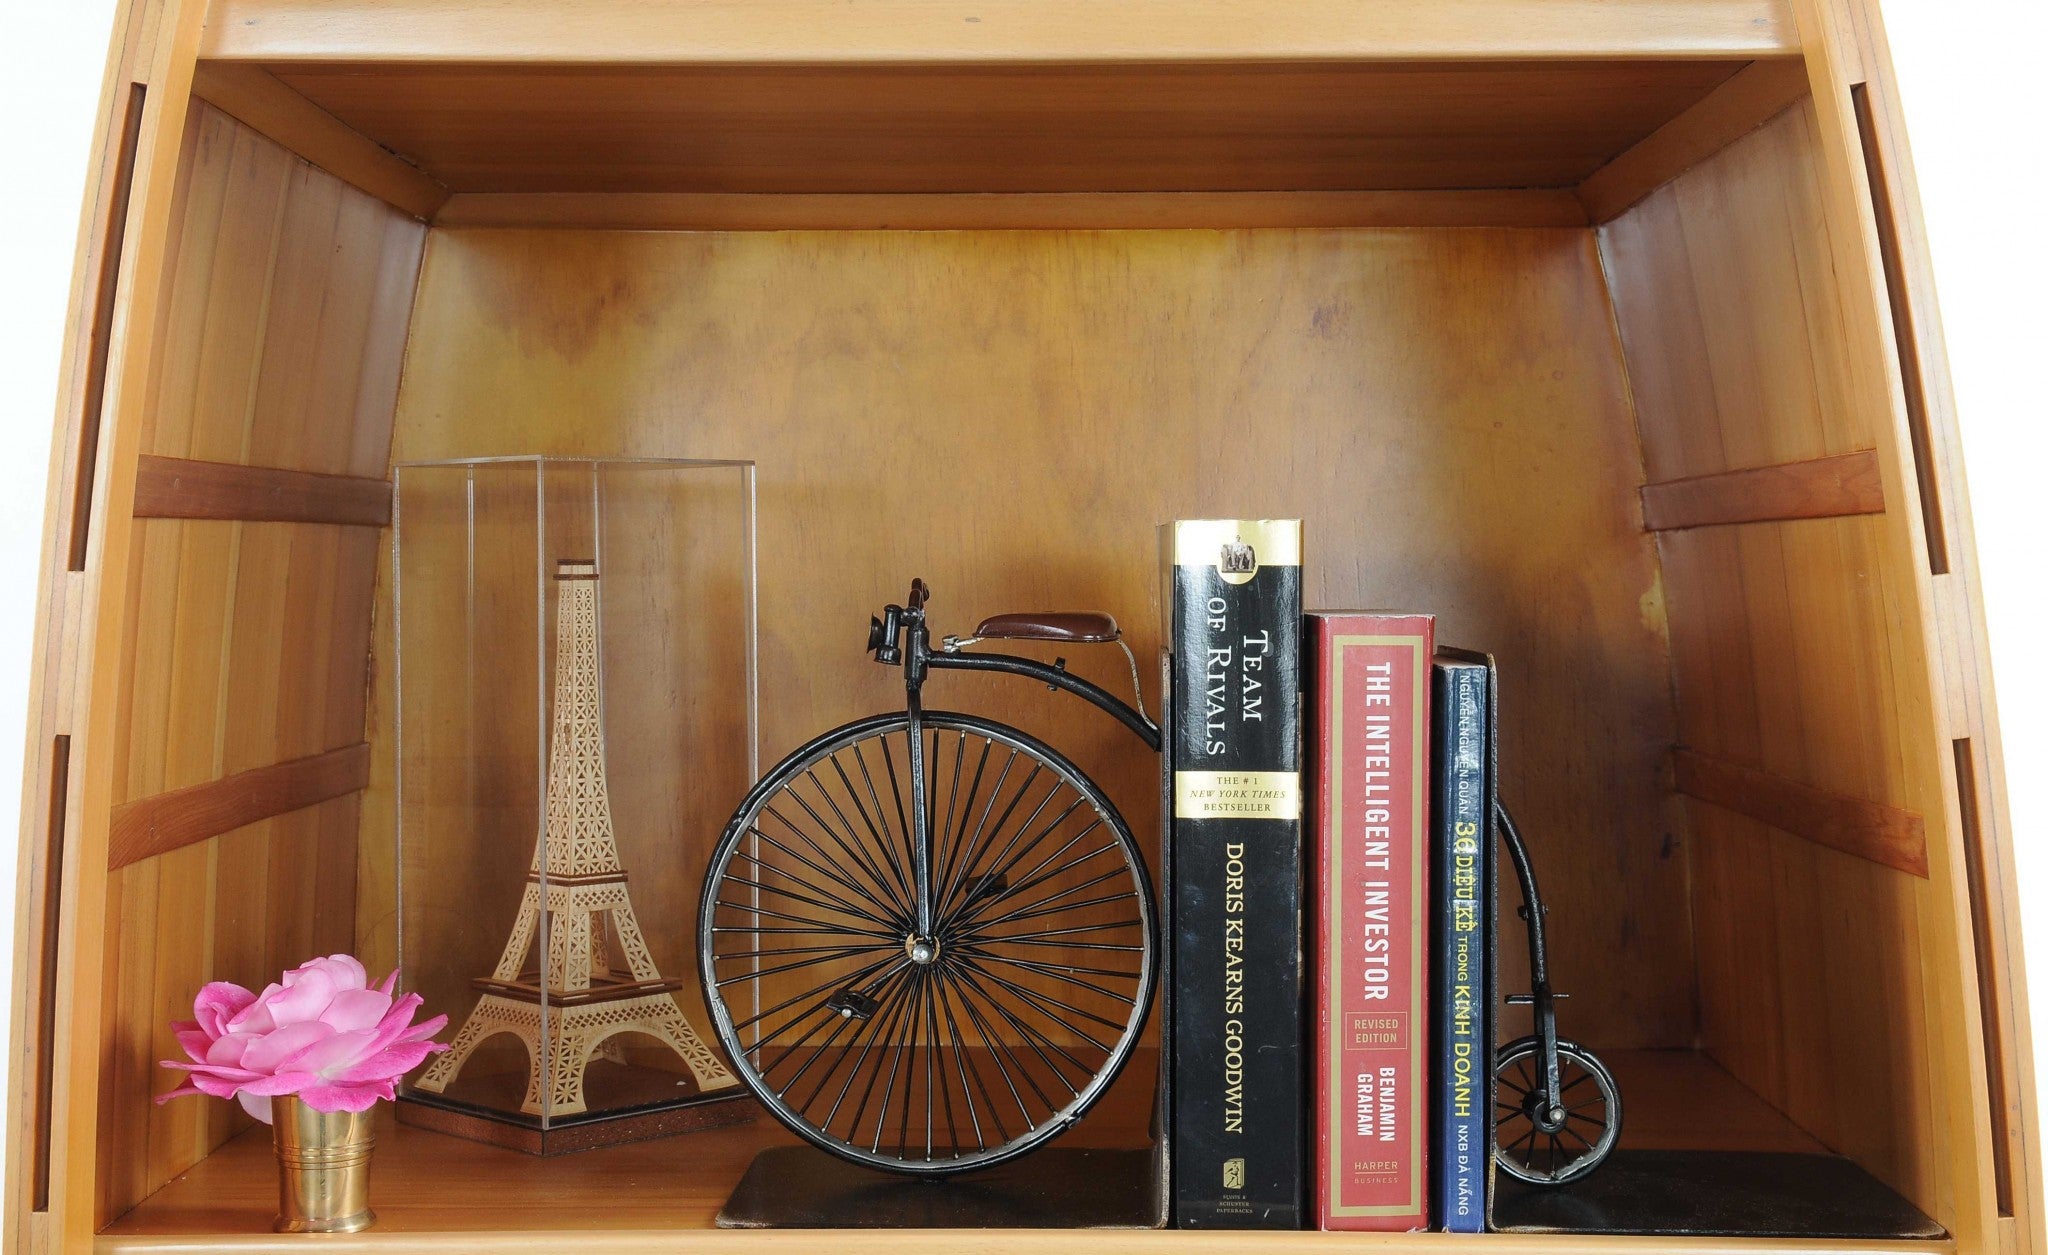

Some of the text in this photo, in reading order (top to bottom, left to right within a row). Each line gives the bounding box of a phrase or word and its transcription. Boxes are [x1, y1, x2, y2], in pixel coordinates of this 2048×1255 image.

[1205, 597, 1232, 756] OF RIVALS
[1242, 629, 1269, 722] TEAM
[1189, 789, 1287, 799] NEW YORK TIMES
[1217, 776, 1240, 785] THE
[1243, 776, 1249, 785] #
[1203, 803, 1271, 812] BESTSELLER
[1364, 661, 1391, 1000] THE INTELLIGENT INVESTOR
[1455, 821, 1477, 853] 36
[1453, 855, 1476, 900] DIỆU
[1457, 935, 1468, 982] TRONG
[1224, 842, 1244, 1134] DORIS KEARNS GOODWIN
[1454, 985, 1471, 1035] KINH
[1354, 1019, 1399, 1030] REVISED
[1355, 1033, 1398, 1043] EDITION
[1454, 1042, 1471, 1117] DOANH
[1357, 1073, 1374, 1136] GRAHAM
[1379, 1067, 1396, 1142] BENJAMIN
[1457, 1124, 1468, 1151] NXB
[1354, 1161, 1398, 1170] HARPER
[1457, 1154, 1471, 1174] ĐÀ
